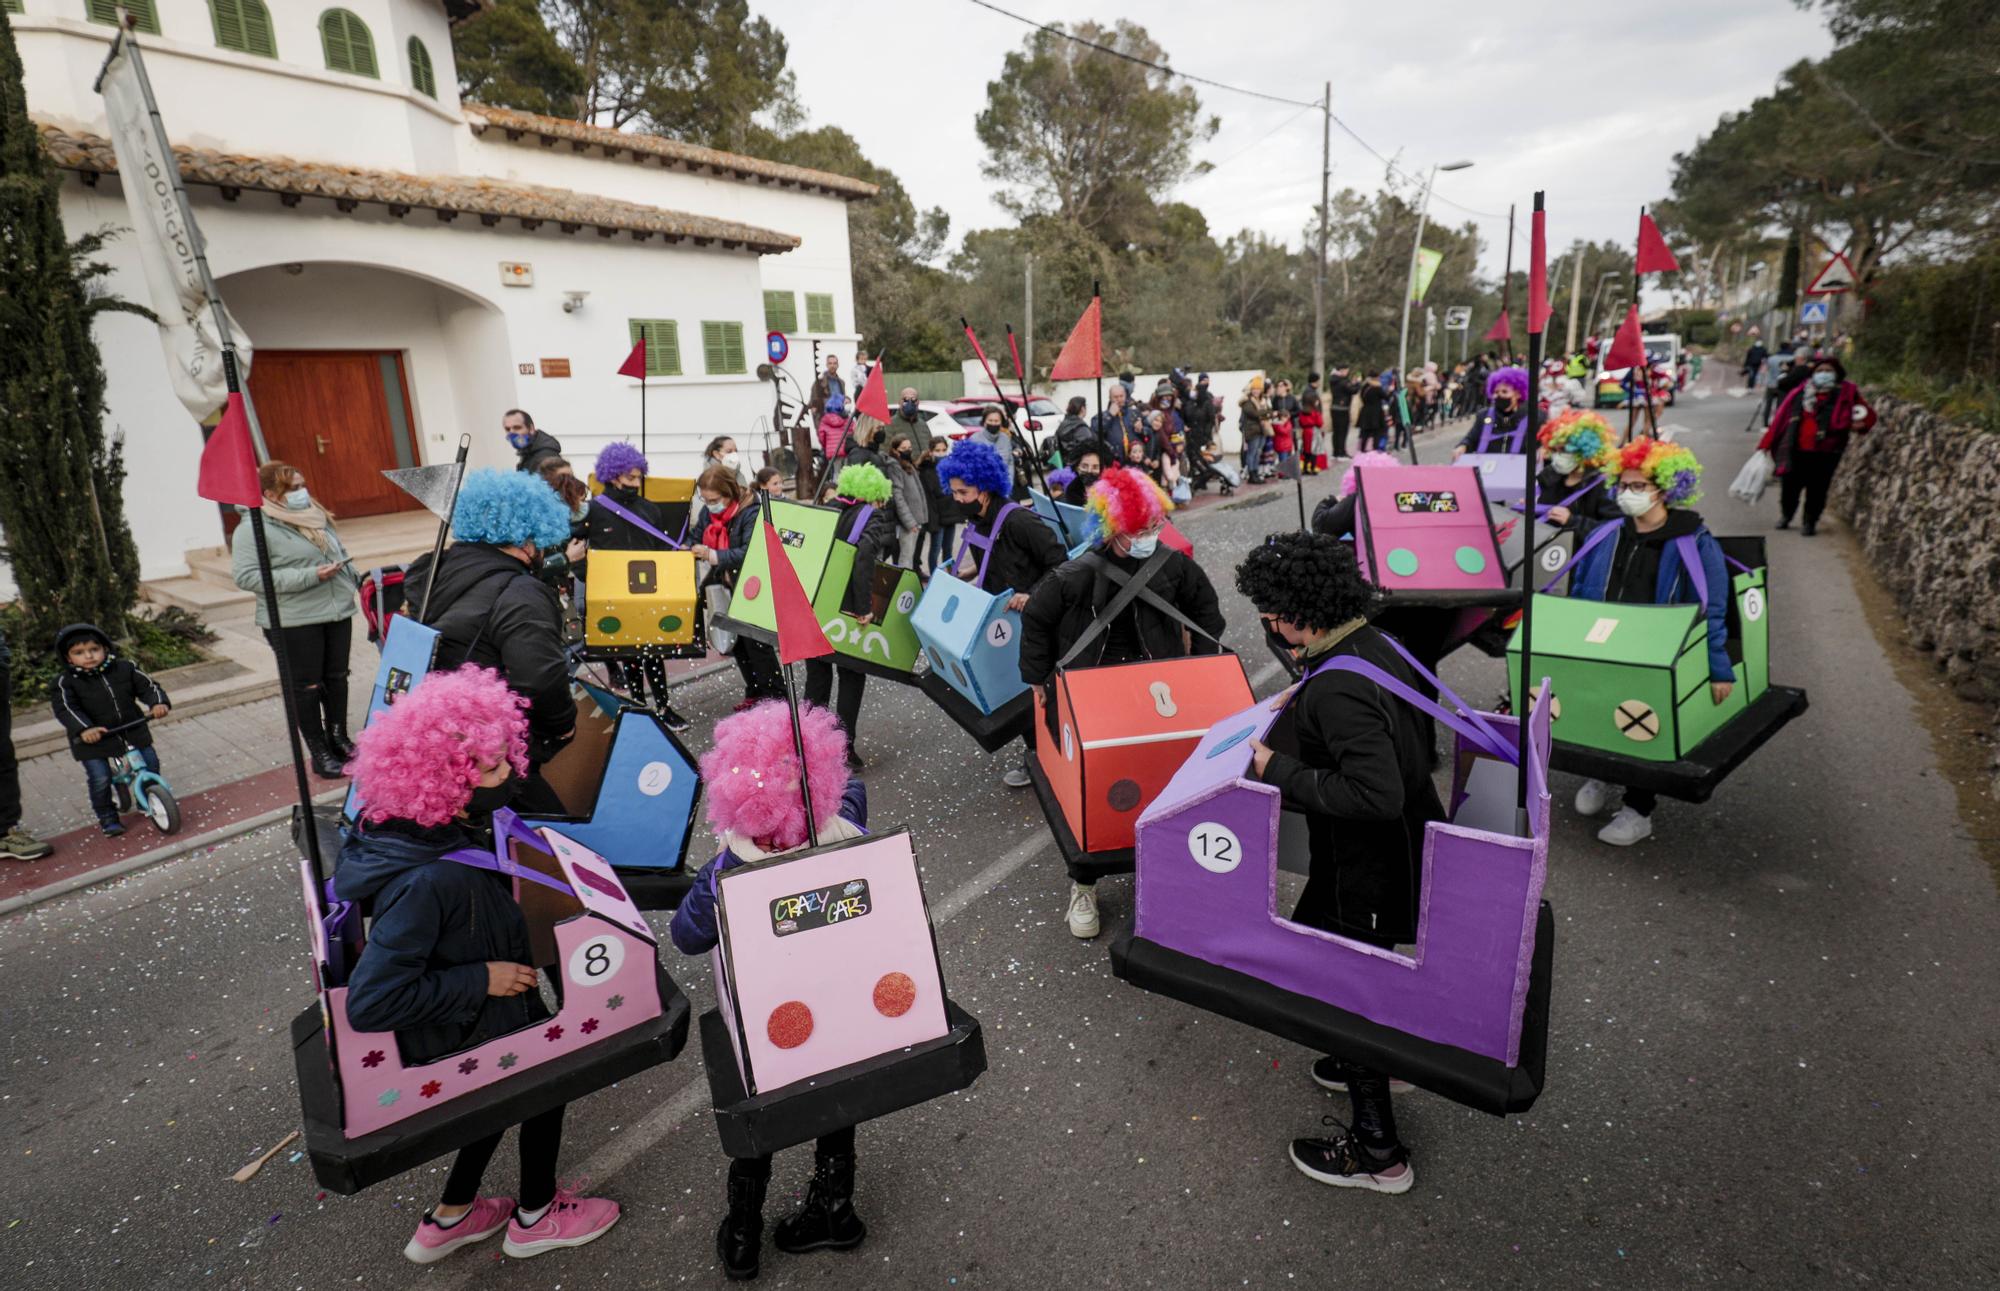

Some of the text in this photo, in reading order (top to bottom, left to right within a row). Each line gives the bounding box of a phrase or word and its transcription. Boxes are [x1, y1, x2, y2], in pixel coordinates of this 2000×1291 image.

[1397, 492, 1433, 506] CRAZY
[1548, 549, 1561, 567] 9
[901, 595, 913, 610] 10
[1748, 593, 1759, 616] 6
[994, 622, 1006, 640] 4
[646, 769, 660, 787] 2
[1196, 832, 1233, 863] 12
[774, 890, 830, 921] CRAZY
[827, 895, 867, 924] CARS
[584, 942, 611, 977] 8
